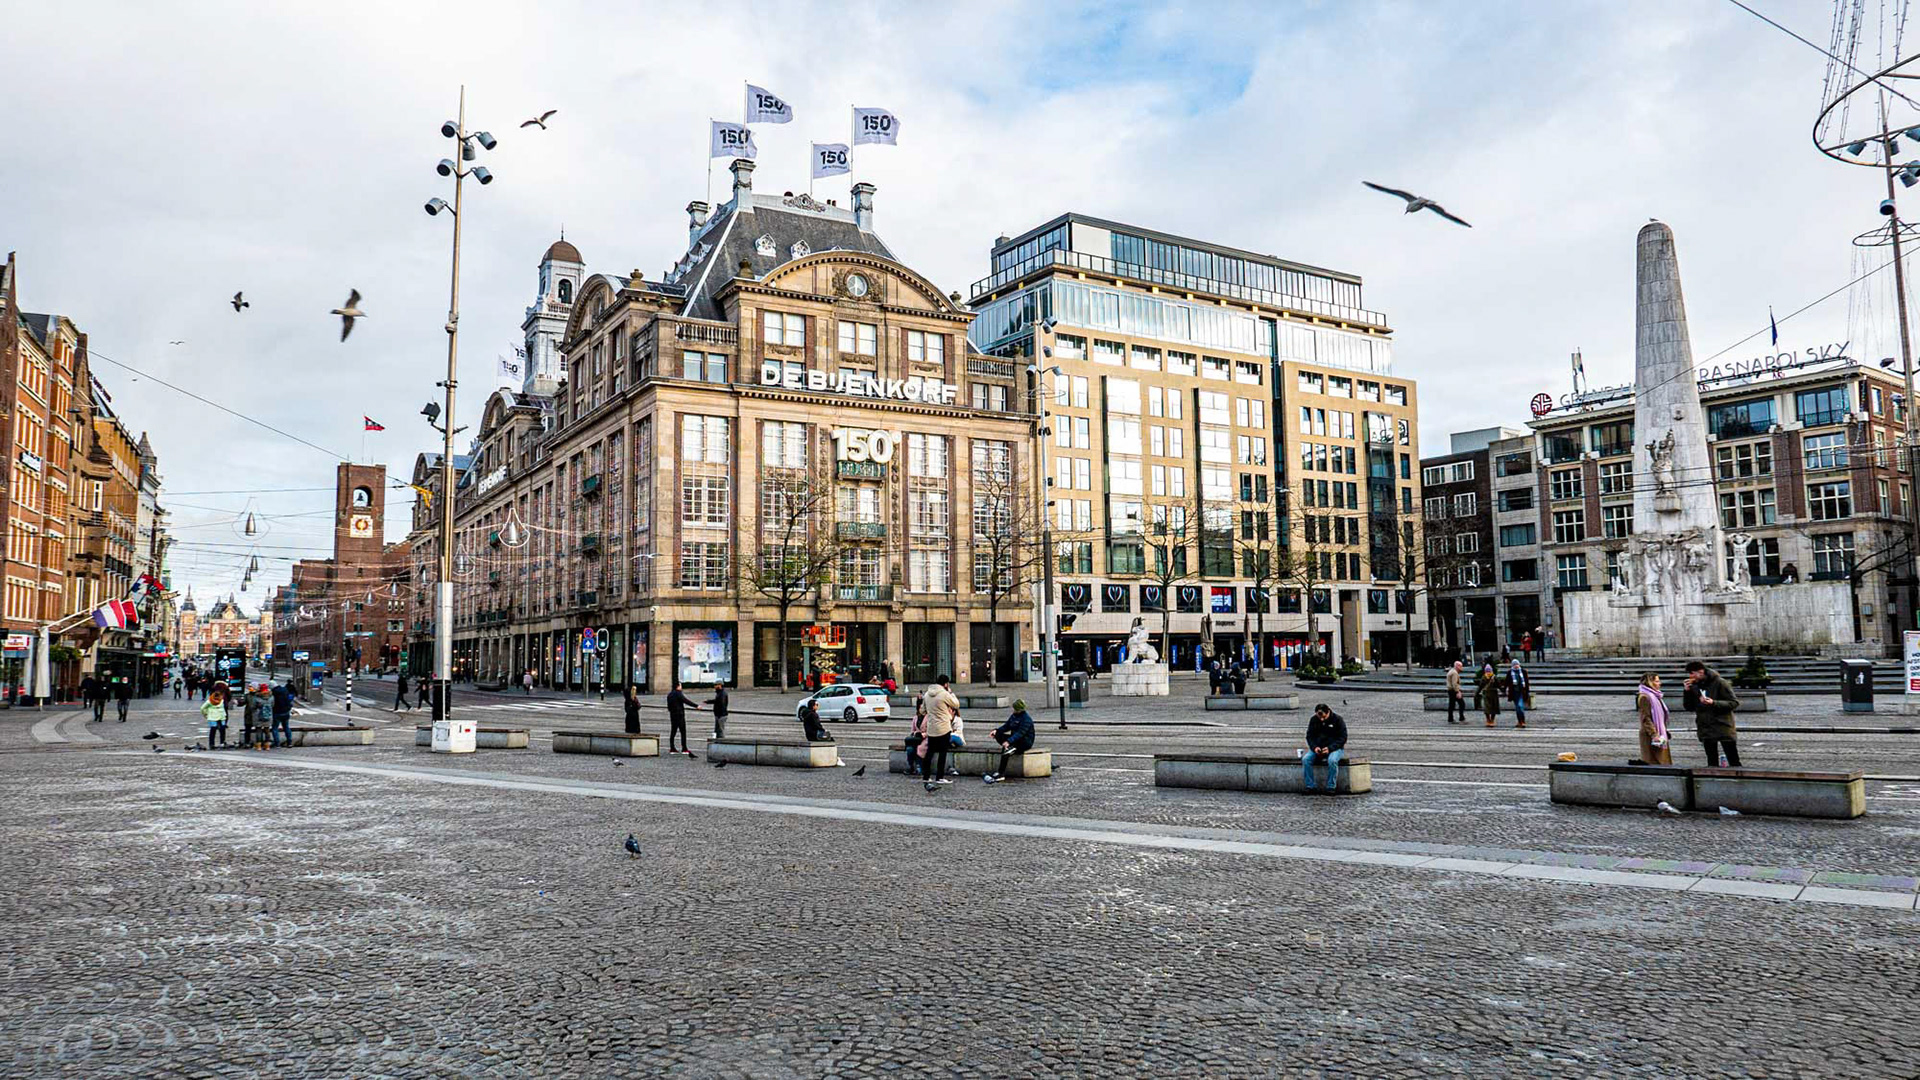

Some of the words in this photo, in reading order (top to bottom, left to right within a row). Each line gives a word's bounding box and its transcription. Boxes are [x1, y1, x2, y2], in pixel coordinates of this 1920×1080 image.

[756, 94, 784, 111] 150
[862, 115, 891, 131] 150
[720, 129, 750, 145] 150
[820, 151, 847, 165] 150
[1694, 340, 1850, 382] RASNAPOLSKY
[760, 364, 802, 388] DE
[808, 369, 959, 405] BIJENKORF
